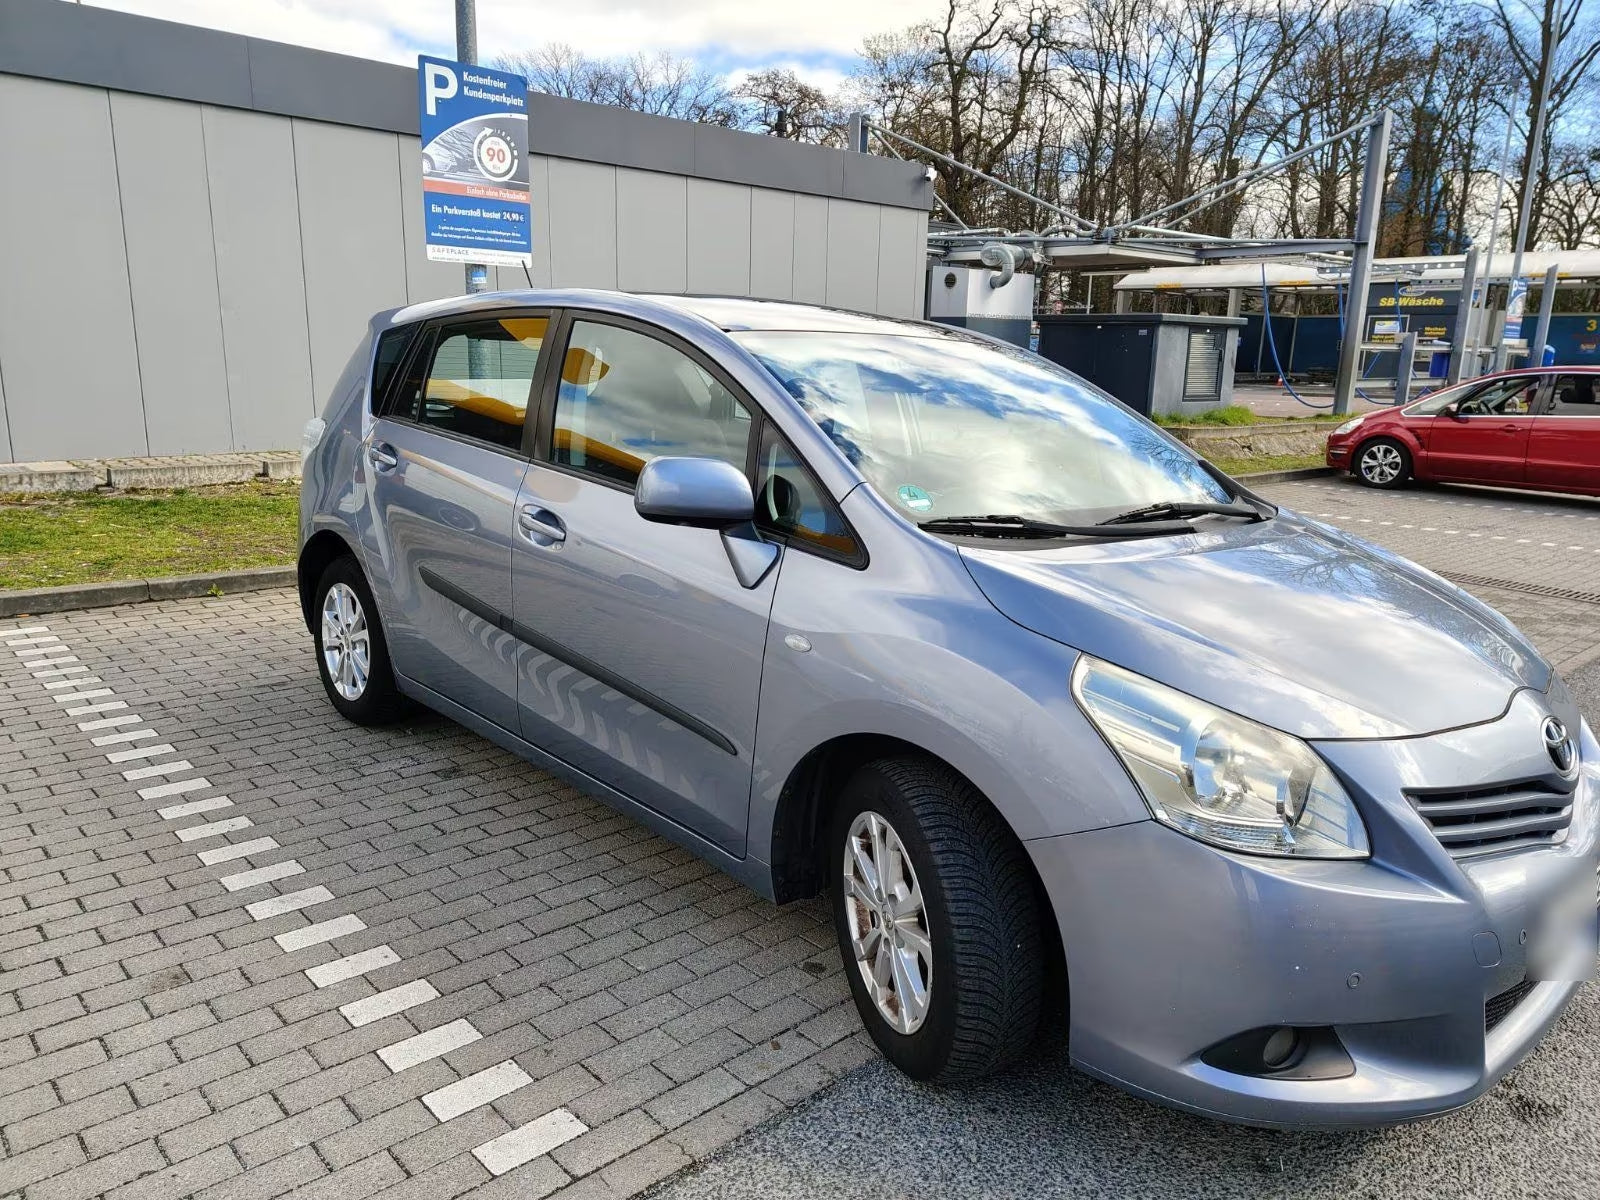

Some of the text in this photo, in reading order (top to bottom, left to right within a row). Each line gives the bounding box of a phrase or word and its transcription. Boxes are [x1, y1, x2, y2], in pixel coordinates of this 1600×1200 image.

[463, 71, 507, 89] Kostenfreier
[424, 62, 458, 116] P
[463, 86, 524, 107] Kundenparkplatz
[486, 147, 506, 163] 90
[466, 186, 485, 195] Einfach
[486, 188, 499, 197] ohne
[431, 203, 442, 213] Ein
[443, 205, 481, 217] Parkverstoß
[482, 209, 501, 219] kostet
[502, 211, 519, 221] 24,90
[1379, 296, 1445, 307] SB-Wäsche
[1585, 319, 1598, 332] 3
